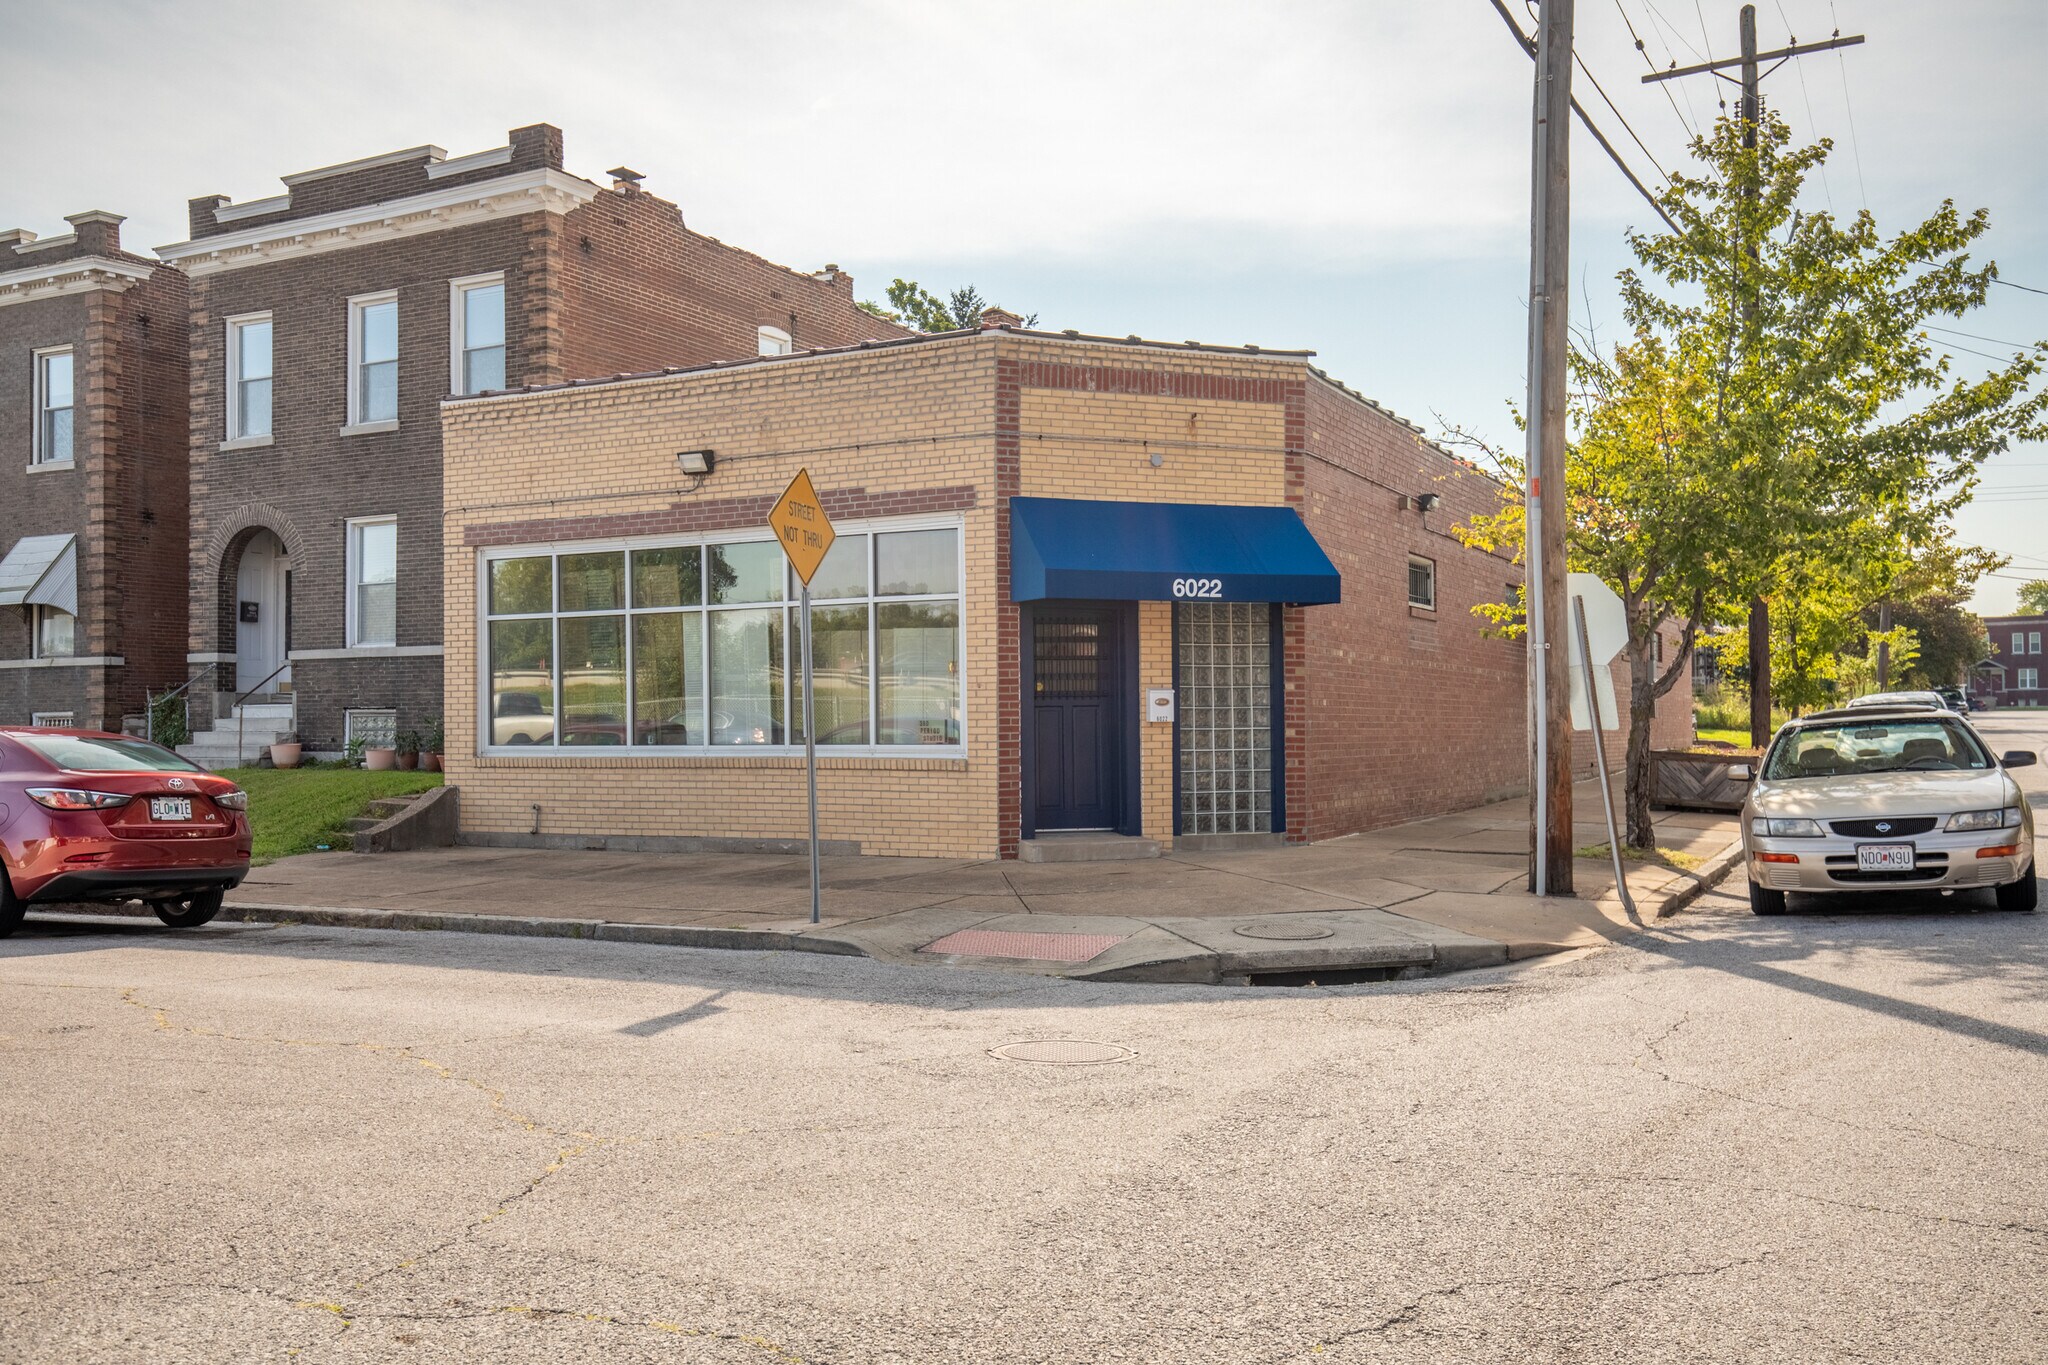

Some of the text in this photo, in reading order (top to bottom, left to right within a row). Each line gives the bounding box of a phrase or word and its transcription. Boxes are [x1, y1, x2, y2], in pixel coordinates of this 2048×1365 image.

[788, 500, 816, 522] STREET
[783, 525, 823, 549] NOT THRU
[1172, 578, 1222, 598] 6022
